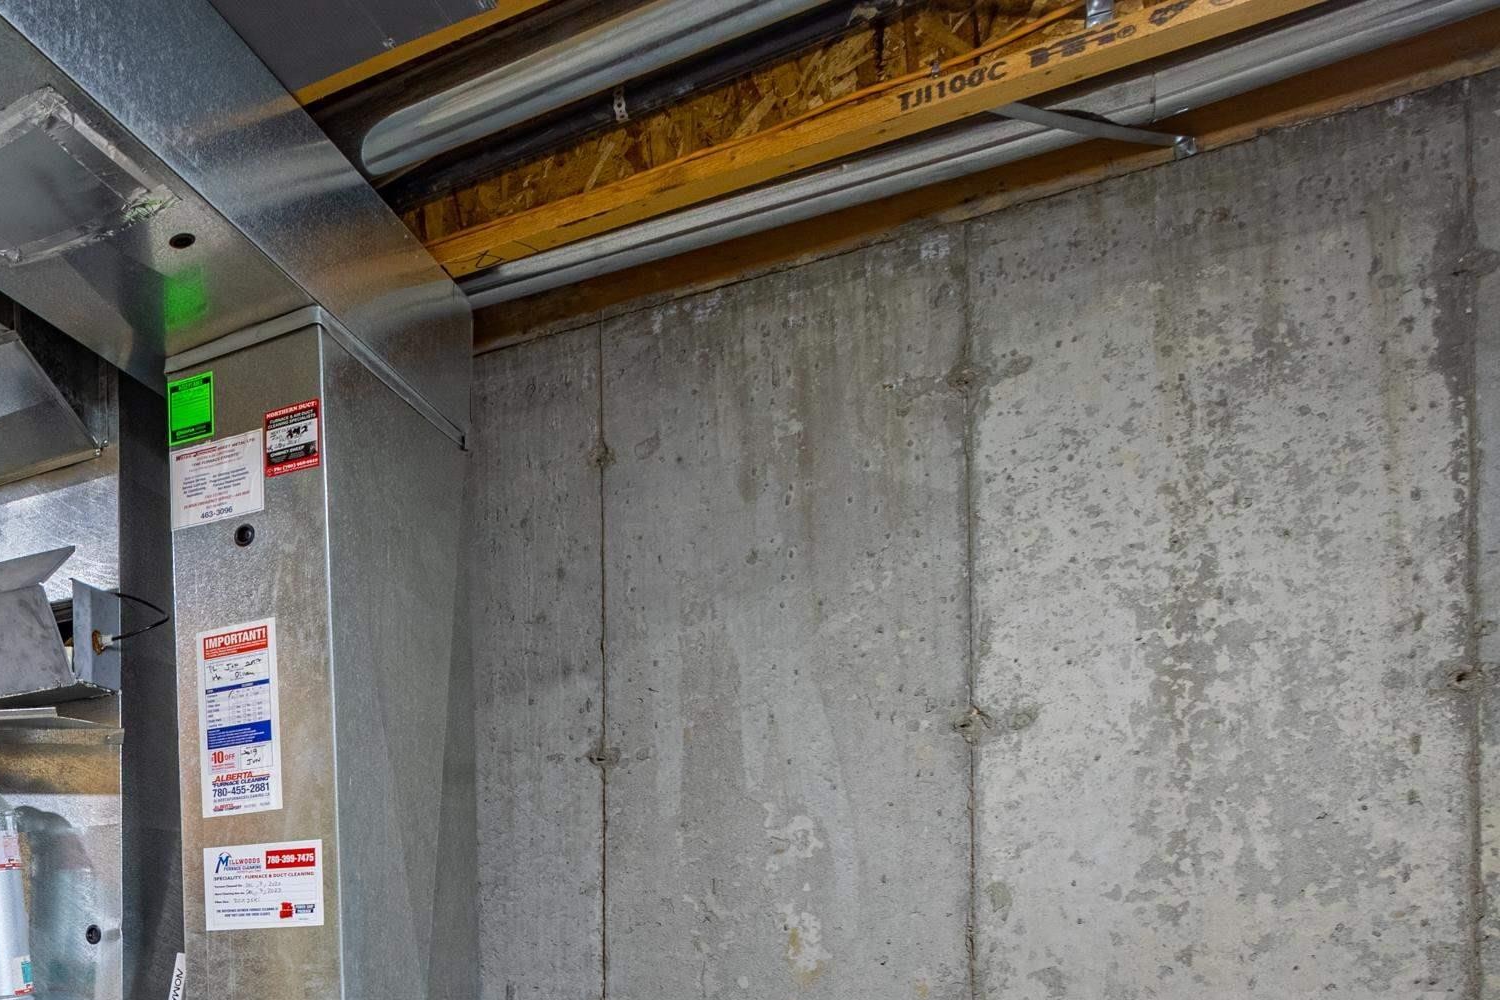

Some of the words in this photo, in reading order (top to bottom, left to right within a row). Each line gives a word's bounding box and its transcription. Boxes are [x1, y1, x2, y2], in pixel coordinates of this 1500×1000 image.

[200, 506, 233, 519] 463-3096
[205, 628, 267, 650] IMPORTANT!
[224, 753, 235, 761] OFF
[212, 780, 240, 788] FURNACE
[240, 776, 270, 785] CLEANING
[214, 771, 254, 783] ALBERTA
[212, 782, 270, 798] 780-455-2881
[215, 855, 260, 873] MILLWOODS
[267, 853, 315, 864] 780-399-7475
